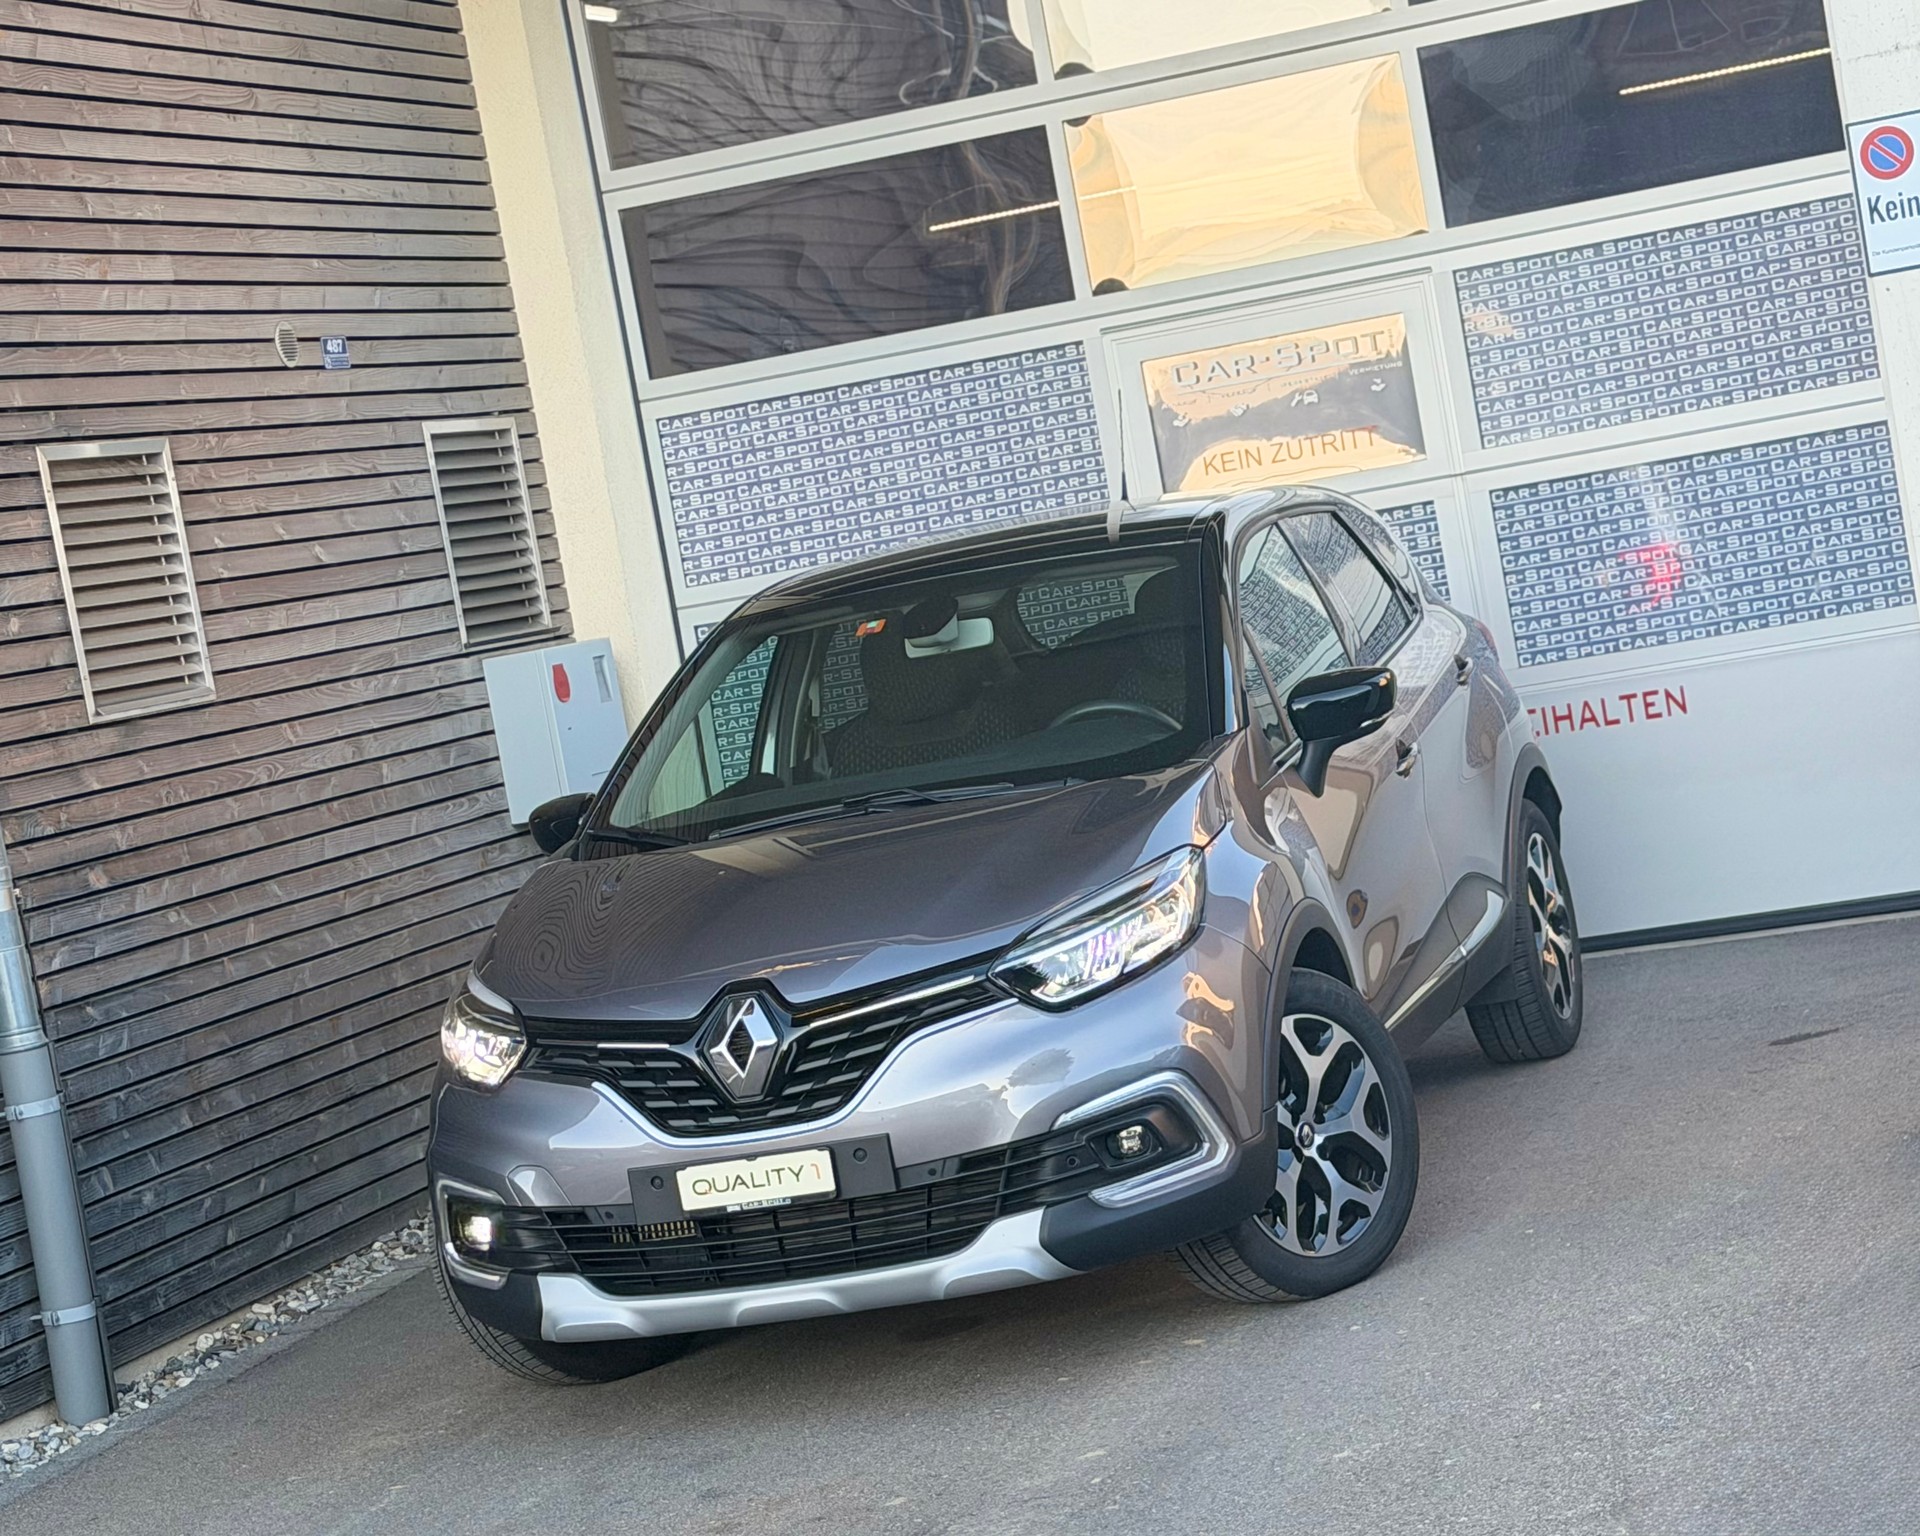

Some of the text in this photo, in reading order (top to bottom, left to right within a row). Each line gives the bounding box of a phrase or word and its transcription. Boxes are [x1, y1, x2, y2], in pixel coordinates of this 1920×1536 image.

[1867, 192, 1920, 225] Kein
[1455, 255, 1554, 283] CAR-SPOT
[1655, 215, 1758, 245] CAR-SPOT
[1759, 197, 1851, 225] CAR-SPO
[1530, 257, 1630, 286] CAR-SPOT
[1631, 238, 1733, 267] CAR-SPOT
[1734, 217, 1839, 247] CAR-SPOT
[1460, 287, 1559, 315] CAR-SPOT
[1559, 267, 1660, 296] CAR-SPOT
[1660, 247, 1763, 277] CAR-SPOT
[1764, 230, 1856, 257] CAR-SPO
[1535, 290, 1635, 318] CAR-SPOT
[1636, 270, 1738, 299] CAR-SPOT
[1466, 321, 1564, 349] CAR-SPOT
[1565, 301, 1666, 330] CAR-SPOT
[1666, 282, 1768, 311] CAR-SPOT
[1770, 264, 1861, 292] CAR-SPO
[1541, 324, 1641, 352] CAR-SPOT
[1641, 304, 1743, 333] CAR-SPOT
[1744, 285, 1849, 314] CAR-SPOT
[327, 339, 343, 353] 487
[1173, 331, 1385, 387] CAR-SPOT
[1471, 353, 1570, 381] CAR-SPOT
[1570, 334, 1671, 362] CAR-SPOT
[1671, 314, 1773, 343] CAR-SPOT
[1774, 297, 1866, 324] CAR-SPO
[1546, 356, 1646, 384] CAR-SPOT
[1646, 337, 1748, 365] CAR-SPOT
[1749, 317, 1853, 346] CAR-SPOT
[657, 356, 1020, 432] CAR-SPOT CAR-SPOT CAR-SPOT CAR-SPOT
[1477, 387, 1575, 415] CAR-SPOT
[1575, 368, 1676, 396] CAR-SPOT
[1676, 349, 1778, 378] CAR-SPOT
[1780, 332, 1871, 359] CAR-SPO
[1551, 390, 1651, 418] CAR-SPOT
[1652, 371, 1754, 400] CAR-SPOT
[1755, 352, 1859, 381] CAR-SPOT
[663, 386, 1025, 461] CAR-SPOT CAR-SPOT CAR-SPOT CAR-SPOT
[725, 410, 814, 436] CAR-SPOT
[815, 393, 906, 419] CAR-SPOT
[906, 377, 998, 403] CAR-SPOT
[730, 440, 820, 466] CAR-SPOT
[820, 424, 911, 449] CAR-SPOT
[911, 407, 1003, 433] CAR-SPOT
[1482, 366, 1876, 448] CAR-SPOT CAR-SPOT CAR-SPOT CAR-SPO
[669, 419, 1031, 493] CAR-SPOT CAR-SPOT CAR-SPOT CAR-SPOT
[736, 473, 826, 498] CAR-SPOT
[826, 456, 917, 482] CAR-SPOT
[917, 440, 1009, 465] CAR-SPOT
[1203, 426, 1378, 476] KEIN ZUTRITT
[1491, 477, 1589, 504] CAR-SPOT
[1590, 459, 1691, 487] CAR-SPOT
[1691, 441, 1794, 469] CAR-SPOT
[1566, 481, 1666, 508] CAR-SPOT
[1667, 463, 1769, 490] CAR-SPOT
[1770, 444, 1874, 472] CAR-SPOT
[675, 450, 1036, 524] CAR-SPOT CAR-SPOT CAR-SPOT CAR-SPOT
[741, 503, 831, 528] CAR-SPOT
[831, 487, 922, 512] CAR-SPOT
[922, 470, 1014, 496] CAR-SPOT
[1496, 509, 1595, 535] CAR-SPOT
[1595, 491, 1696, 518] CAR-SPOT
[1696, 473, 1799, 501] CAR-SPOT
[1571, 513, 1671, 540] CAR-SPOT
[1672, 495, 1774, 522] CAR-SPOT
[1775, 477, 1879, 505] CAR-SPOT
[680, 483, 1042, 556] CAR-SPOT CAR-SPOT CAR-SPOT CAR-SPOT
[747, 536, 837, 560] CAR-SPOT
[837, 519, 928, 545] CAR-SPOT
[928, 503, 1020, 528] CAR-SPOT
[1502, 542, 1600, 569] CAR-SPOT
[1601, 525, 1701, 552] CAR-SPOT
[1702, 507, 1805, 535] CAR-SPOT
[1576, 547, 1677, 573] CAR-SPOT
[1678, 529, 1780, 556] CAR-SPOT
[1780, 512, 1884, 539] CAR-SPOT
[686, 562, 775, 587] CAR-SPOT
[1507, 574, 1605, 600] CAR-SPOT
[1606, 557, 1706, 583] CAR-SPOT
[1707, 540, 1810, 567] CAR-SPOT
[1582, 578, 1682, 604] CAR-SPOT
[1683, 561, 1785, 588] CAR-SPOT
[1786, 544, 1889, 571] CAR-SPOT
[1512, 607, 1611, 633] CAR-SPOT
[1612, 591, 1712, 617] CAR-SPOT
[1713, 574, 1815, 601] CAR-SPOT
[1587, 612, 1688, 638] CAR-SPOT
[1688, 596, 1790, 622] CAR-SPOT
[1791, 579, 1895, 606] CAR-SPOT
[1518, 641, 1617, 666] CAR-SPOT
[1617, 625, 1718, 651] CAR-SPOT
[1718, 608, 1821, 635] CAR-SPOT
[692, 1164, 804, 1196] QUALITY
